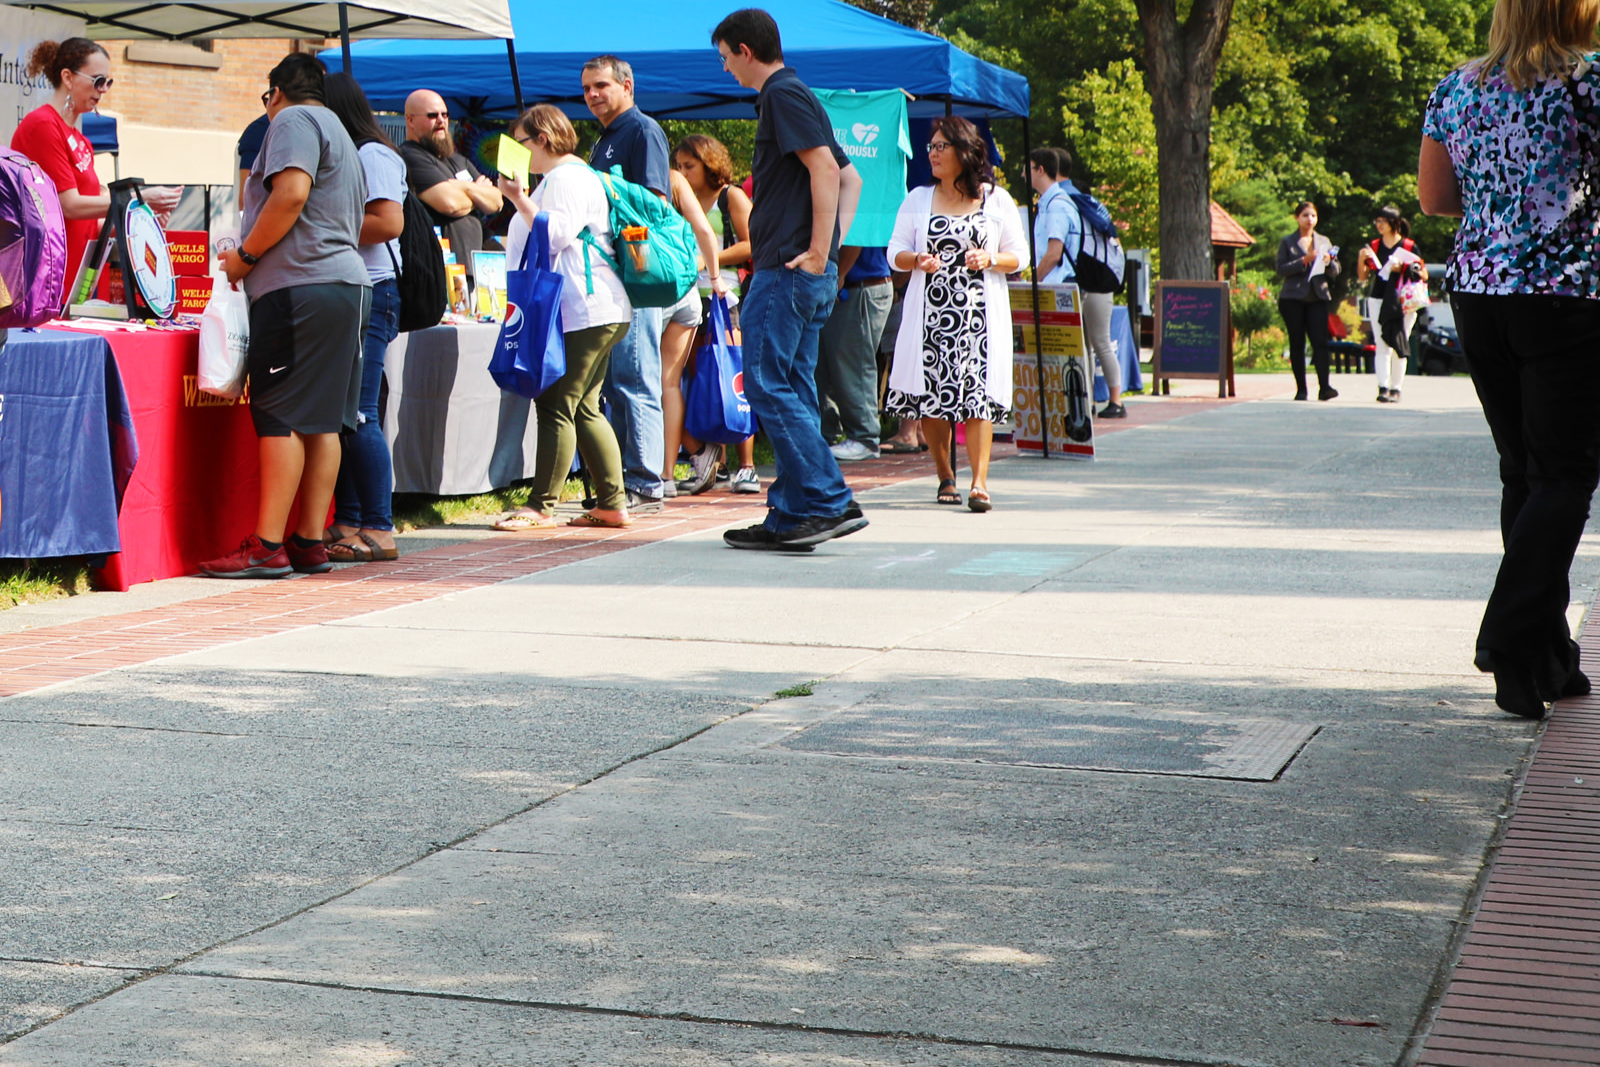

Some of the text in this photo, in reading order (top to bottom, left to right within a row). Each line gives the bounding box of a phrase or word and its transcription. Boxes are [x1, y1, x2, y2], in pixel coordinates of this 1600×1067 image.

[170, 244, 205, 253] WELLS
[171, 254, 205, 263] FARGO
[182, 289, 212, 298] WELLS
